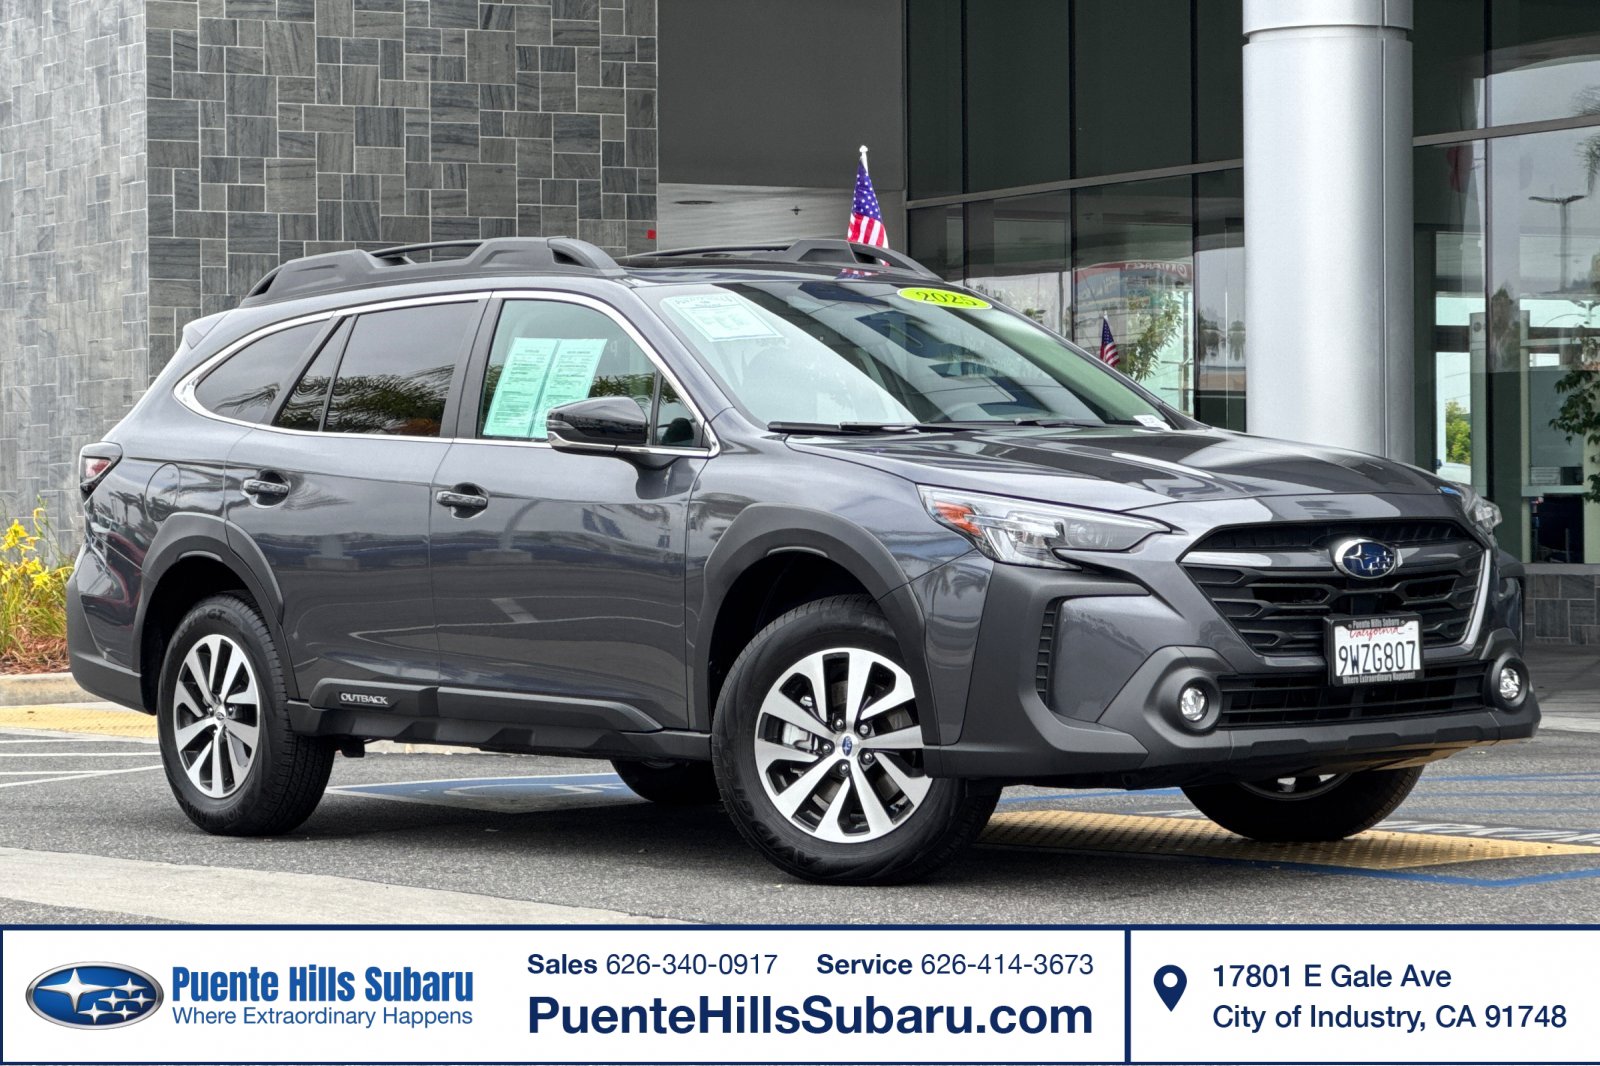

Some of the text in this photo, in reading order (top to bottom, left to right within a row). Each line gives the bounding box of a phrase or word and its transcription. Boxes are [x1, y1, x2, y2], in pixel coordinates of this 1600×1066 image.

[915, 291, 978, 306] 2025
[1339, 641, 1415, 675] 9WZG807
[340, 692, 388, 705] OUTBACK
